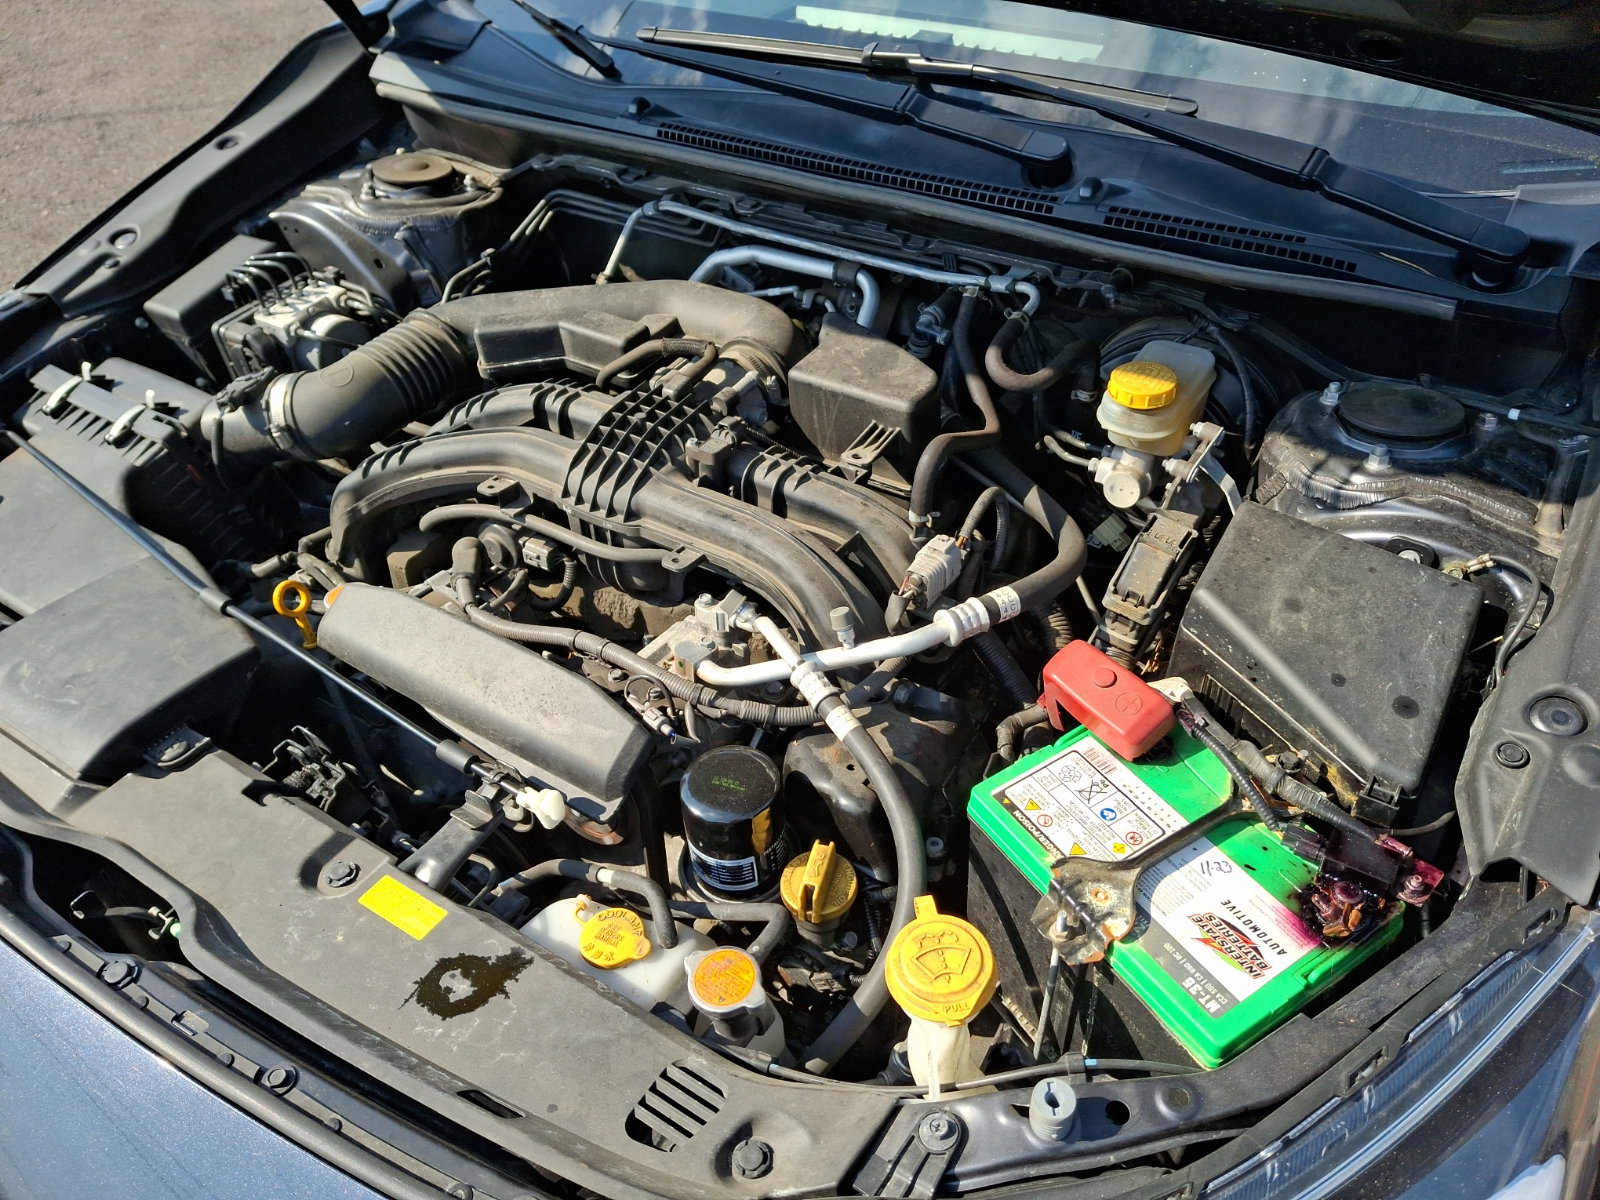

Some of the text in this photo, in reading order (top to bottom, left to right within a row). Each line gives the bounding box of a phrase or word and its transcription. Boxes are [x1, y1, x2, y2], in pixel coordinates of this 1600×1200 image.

[1099, 778, 1109, 788] Pb
[1012, 809, 1064, 858] ANGER/POISON
[832, 863, 855, 906] ENGINE OIL
[598, 908, 642, 936] COOLANT
[1220, 898, 1288, 956] AUTOMOTIVE
[1163, 941, 1175, 953] 100
[1190, 914, 1261, 979] INTERSTATE
[1203, 913, 1269, 969] BATTERIES
[1181, 975, 1222, 1015] MT-35
[1205, 982, 1218, 995] 550
[1215, 991, 1229, 1004] CCA
[943, 1002, 970, 1012] PULL
